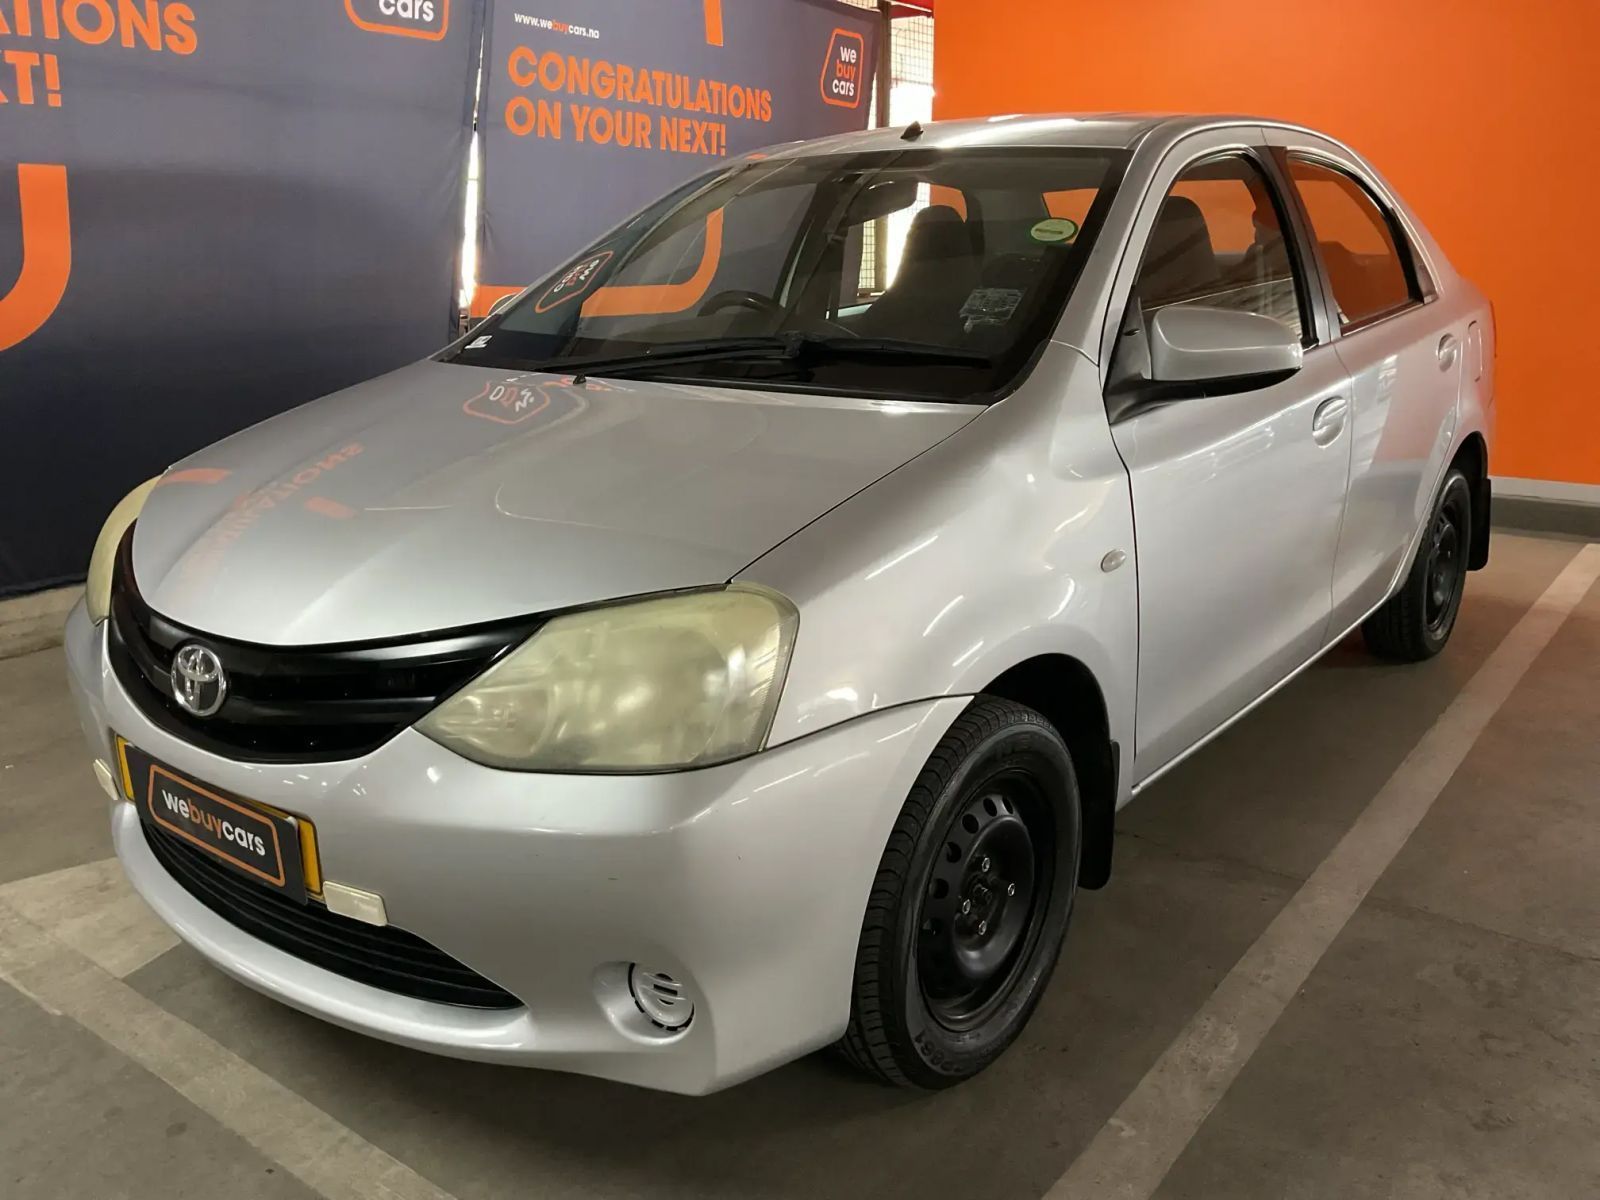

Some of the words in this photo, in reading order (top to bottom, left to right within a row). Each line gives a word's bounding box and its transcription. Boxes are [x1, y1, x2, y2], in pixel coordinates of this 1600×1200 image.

[0, 0, 198, 55] TIONS
[378, 0, 434, 22] cars
[514, 13, 600, 39] www.webuycars.na
[836, 59, 856, 81] buy
[840, 46, 857, 64] we
[0, 50, 62, 107] T!
[507, 45, 772, 122] CONGRATULATIONS
[832, 79, 855, 96] cars
[505, 96, 561, 139] ON
[570, 103, 652, 149] YOUR
[659, 115, 726, 156] NEXT!
[162, 789, 266, 856] webuycars
